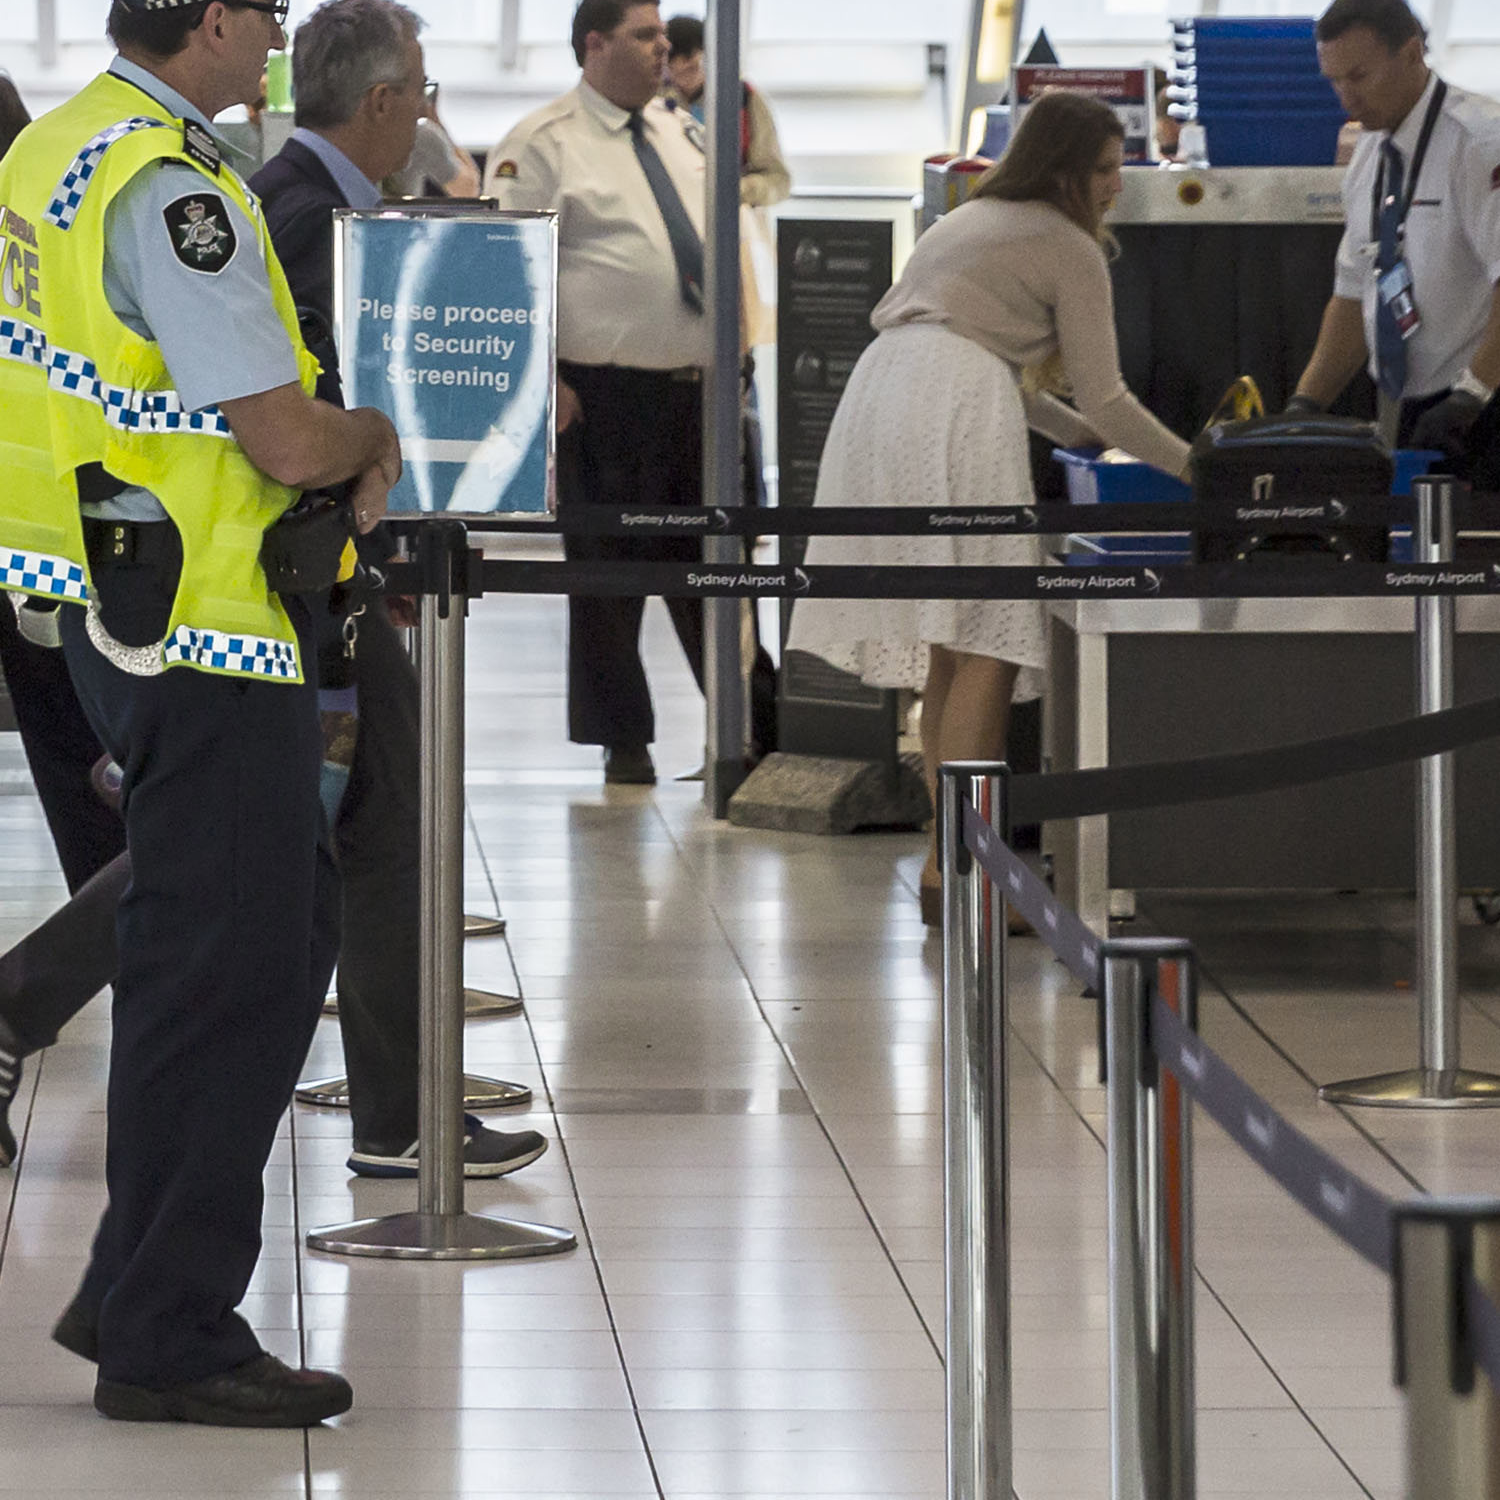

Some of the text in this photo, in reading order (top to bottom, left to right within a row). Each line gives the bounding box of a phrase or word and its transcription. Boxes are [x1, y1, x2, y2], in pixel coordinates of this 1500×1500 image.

[358, 299, 546, 327] Please proceed
[382, 332, 515, 361] to Security
[386, 362, 511, 392] Screening
[621, 512, 708, 526] Sydney Airport
[929, 513, 1016, 527] Sydney Airport
[687, 573, 786, 587] Sydney Airport
[1037, 575, 1135, 590] Sydney Airport
[1386, 571, 1485, 587] Sydney Airport
